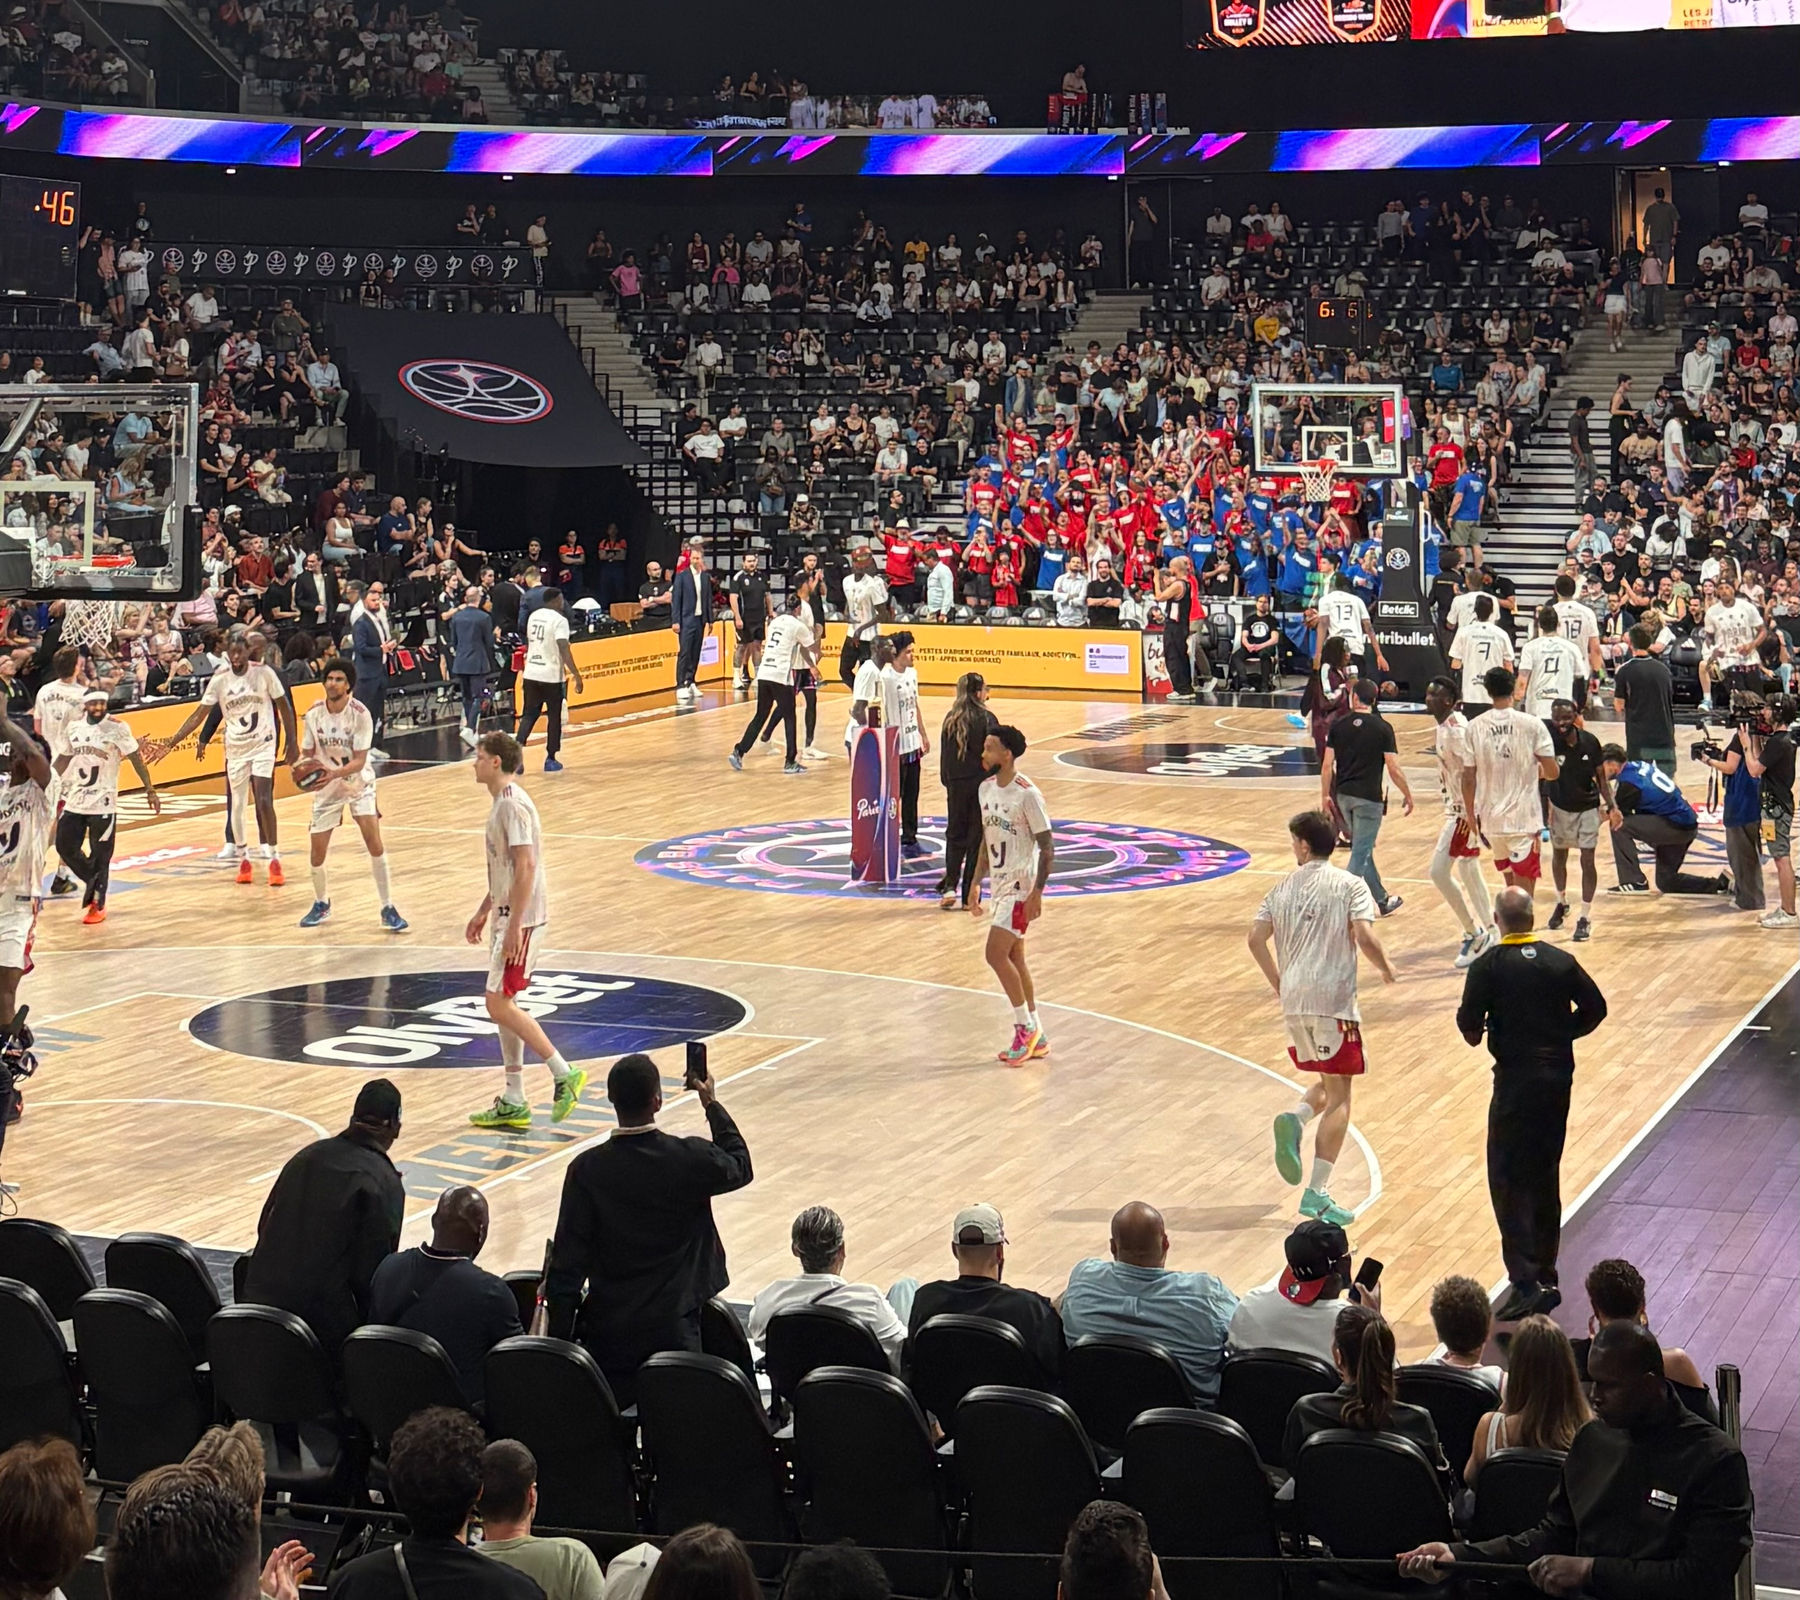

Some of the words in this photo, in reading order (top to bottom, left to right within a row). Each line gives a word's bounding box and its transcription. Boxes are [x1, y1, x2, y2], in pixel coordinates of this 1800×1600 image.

[1381, 604, 1415, 615] Betclic
[1362, 630, 1437, 646] ntribullet.
[857, 799, 881, 820] Paris
